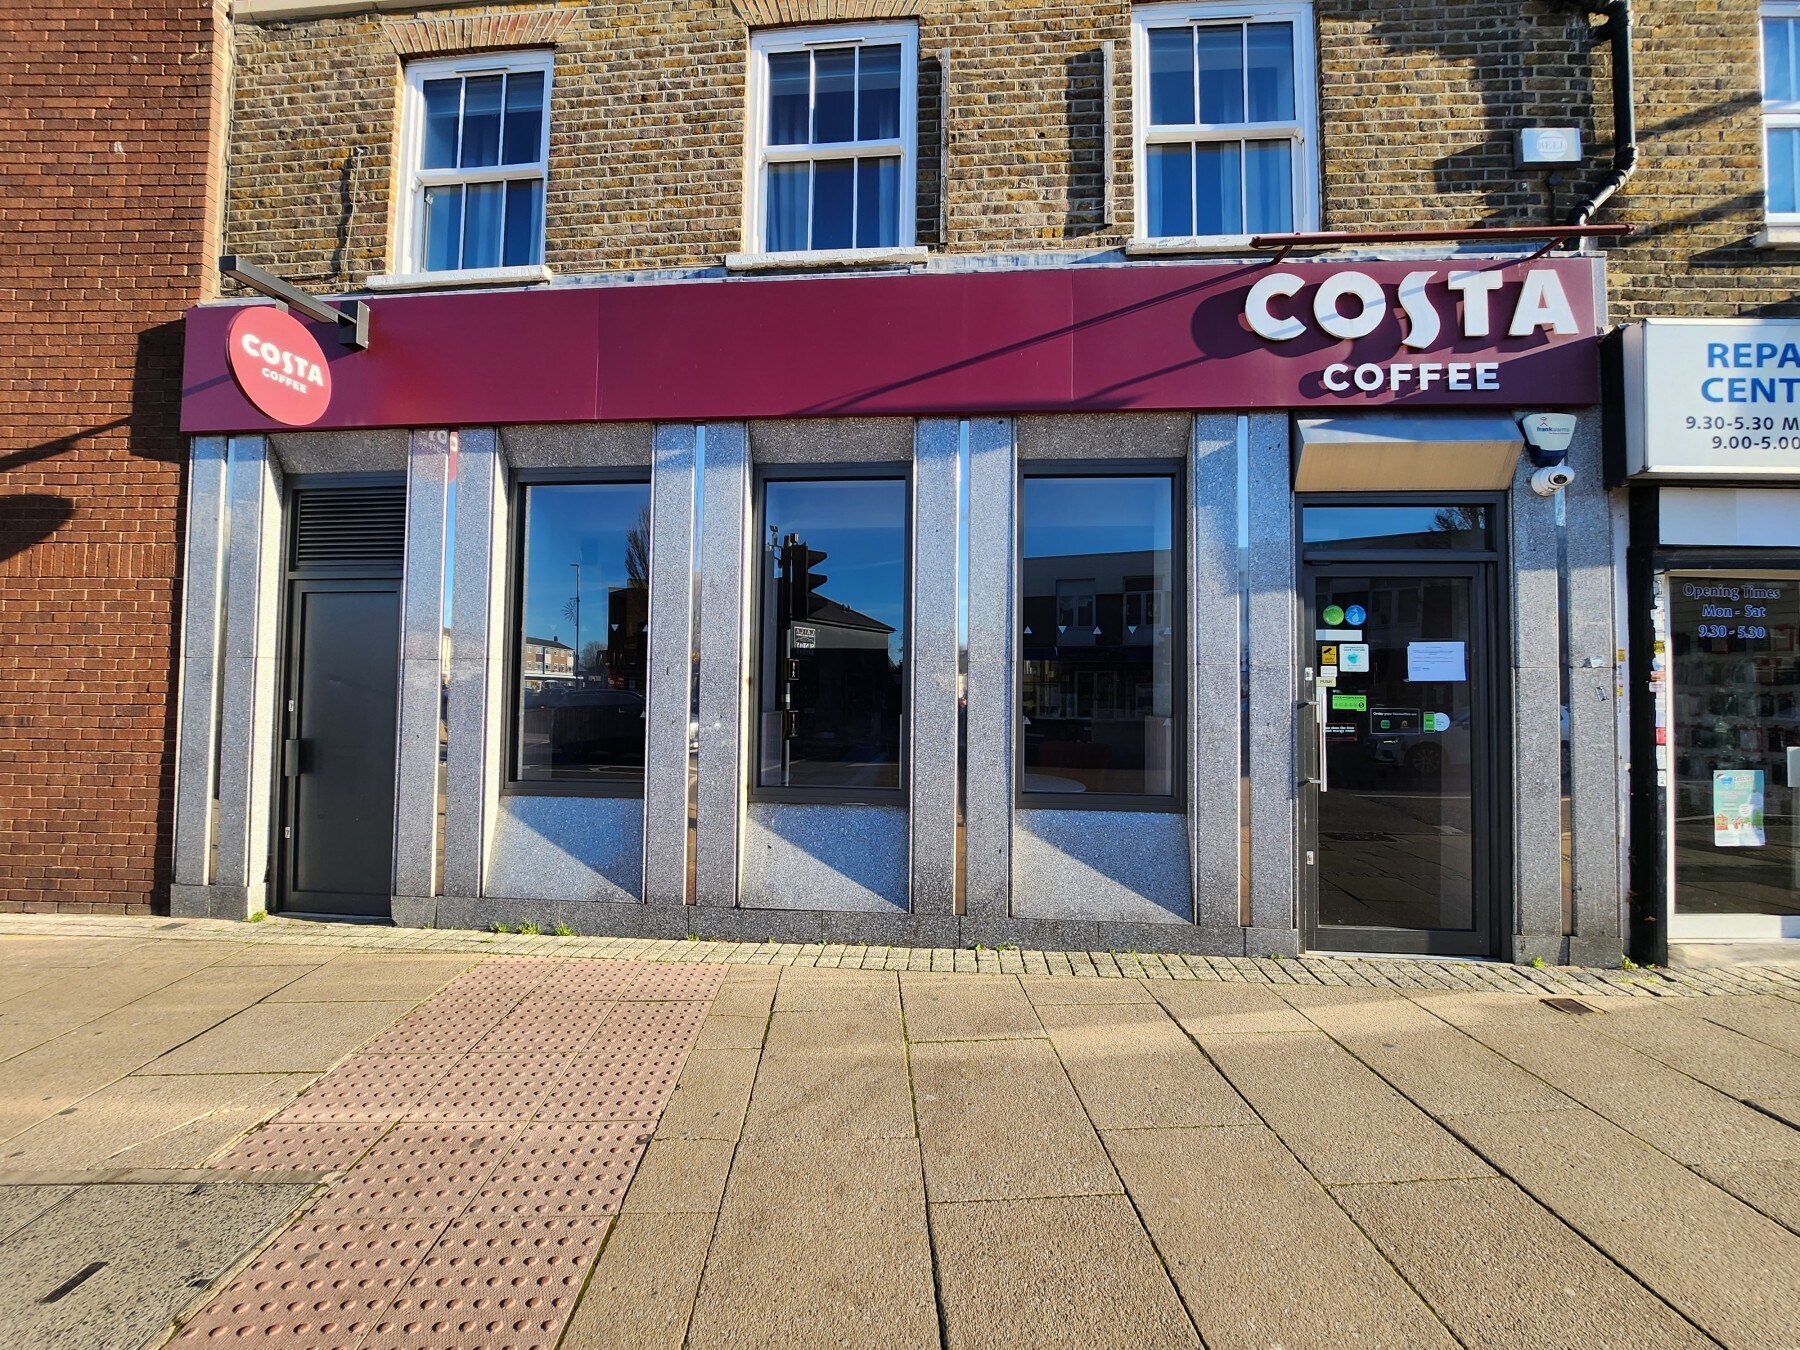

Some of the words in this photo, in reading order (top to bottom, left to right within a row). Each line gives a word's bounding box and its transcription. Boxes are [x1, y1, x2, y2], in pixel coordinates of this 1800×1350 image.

[1245, 269, 1579, 349] COSTA
[241, 333, 324, 387] COSTA
[1707, 342, 1800, 369] REPA
[261, 367, 308, 394] COFFEE
[1323, 362, 1500, 391] COFFEE
[1701, 377, 1800, 403] CENT
[1685, 415, 1774, 430] 9.30-5.30
[1712, 435, 1800, 450] 9.00-5.00
[1683, 583, 1740, 601] Opening
[1742, 584, 1781, 599] Times
[1702, 604, 1733, 618] Mon
[1744, 604, 1767, 618] Sat
[1698, 624, 1727, 638] 9.30
[1737, 625, 1766, 639] 5.30
